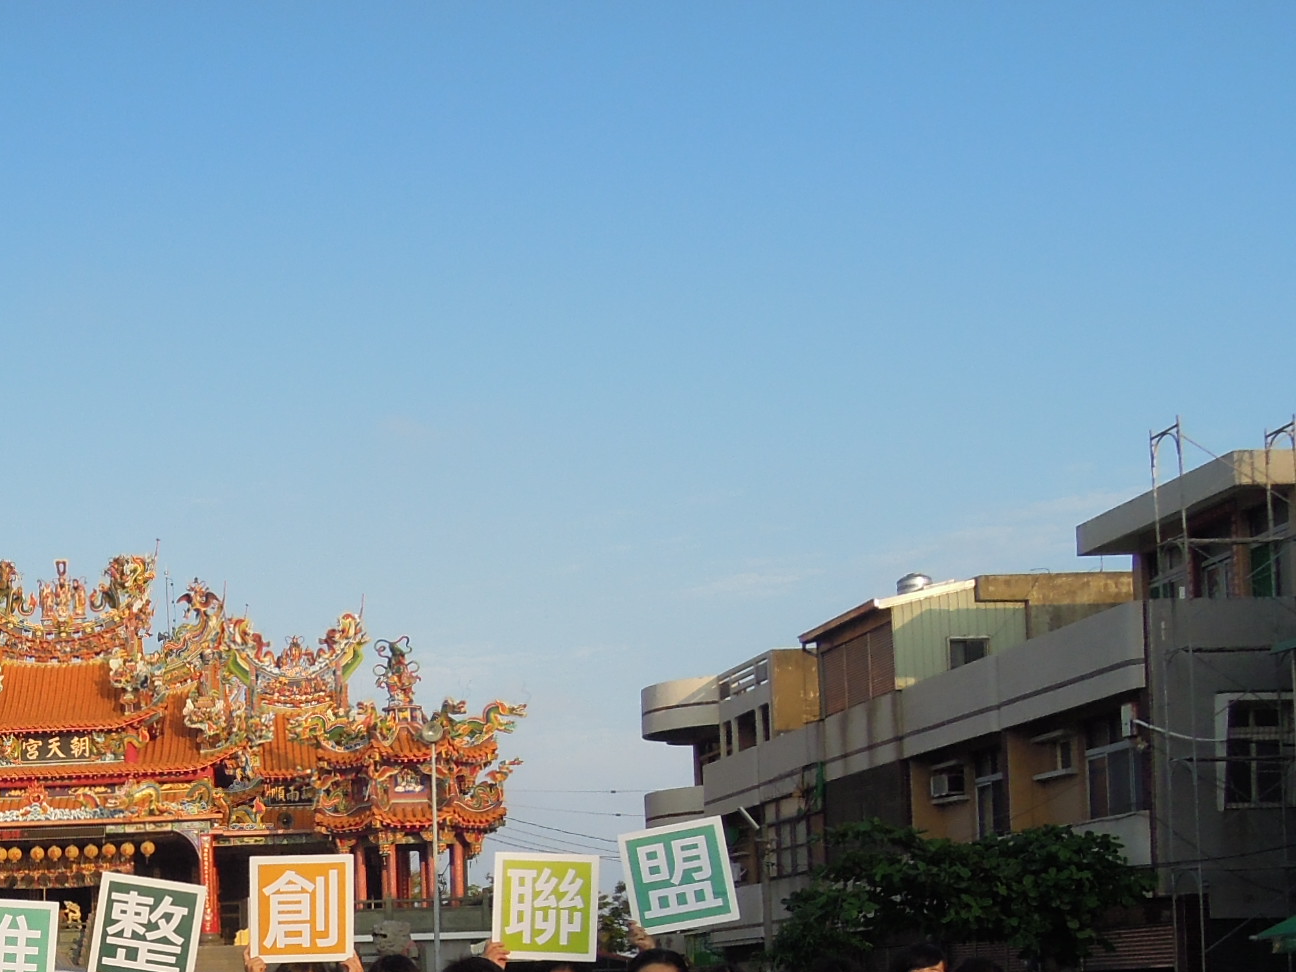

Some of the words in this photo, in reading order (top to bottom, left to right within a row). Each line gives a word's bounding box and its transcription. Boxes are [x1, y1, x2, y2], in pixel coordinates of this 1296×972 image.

[262, 868, 340, 948] 創
[505, 868, 585, 946] 聯
[634, 833, 723, 921] 盟
